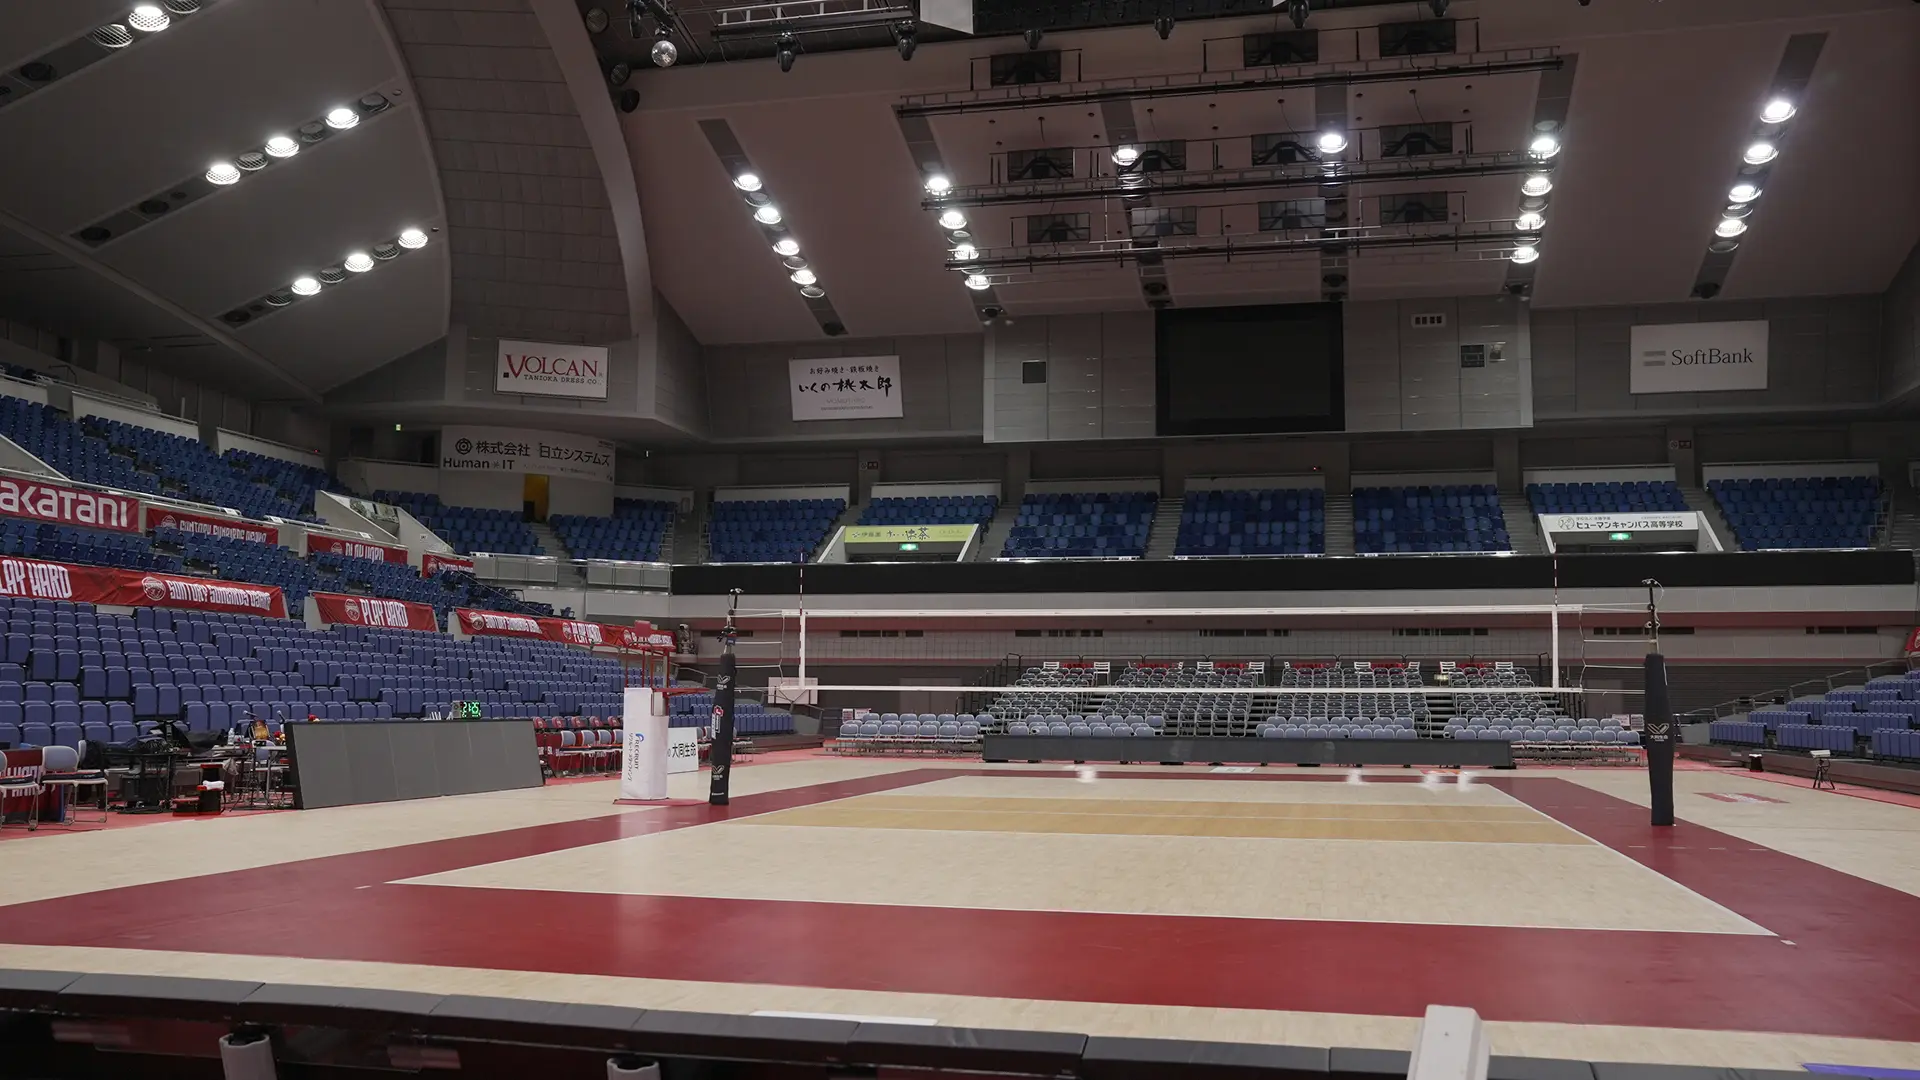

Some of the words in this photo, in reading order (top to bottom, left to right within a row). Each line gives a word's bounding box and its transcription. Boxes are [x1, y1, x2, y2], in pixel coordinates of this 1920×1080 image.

[505, 354, 598, 378] VOLCAN
[1671, 348, 1753, 366] SoftBank
[524, 374, 559, 383] TANIOKA
[560, 377, 585, 385] DRESS
[798, 375, 892, 397] いくの桃太郎
[443, 457, 490, 469] Human
[502, 459, 515, 470] IT
[475, 440, 530, 458] 株式会社
[539, 444, 611, 467] 日立システムズ
[26, 562, 73, 598] HARD
[359, 599, 386, 626] PLAY
[383, 601, 409, 627] HARD
[672, 742, 697, 758] 大同生命
